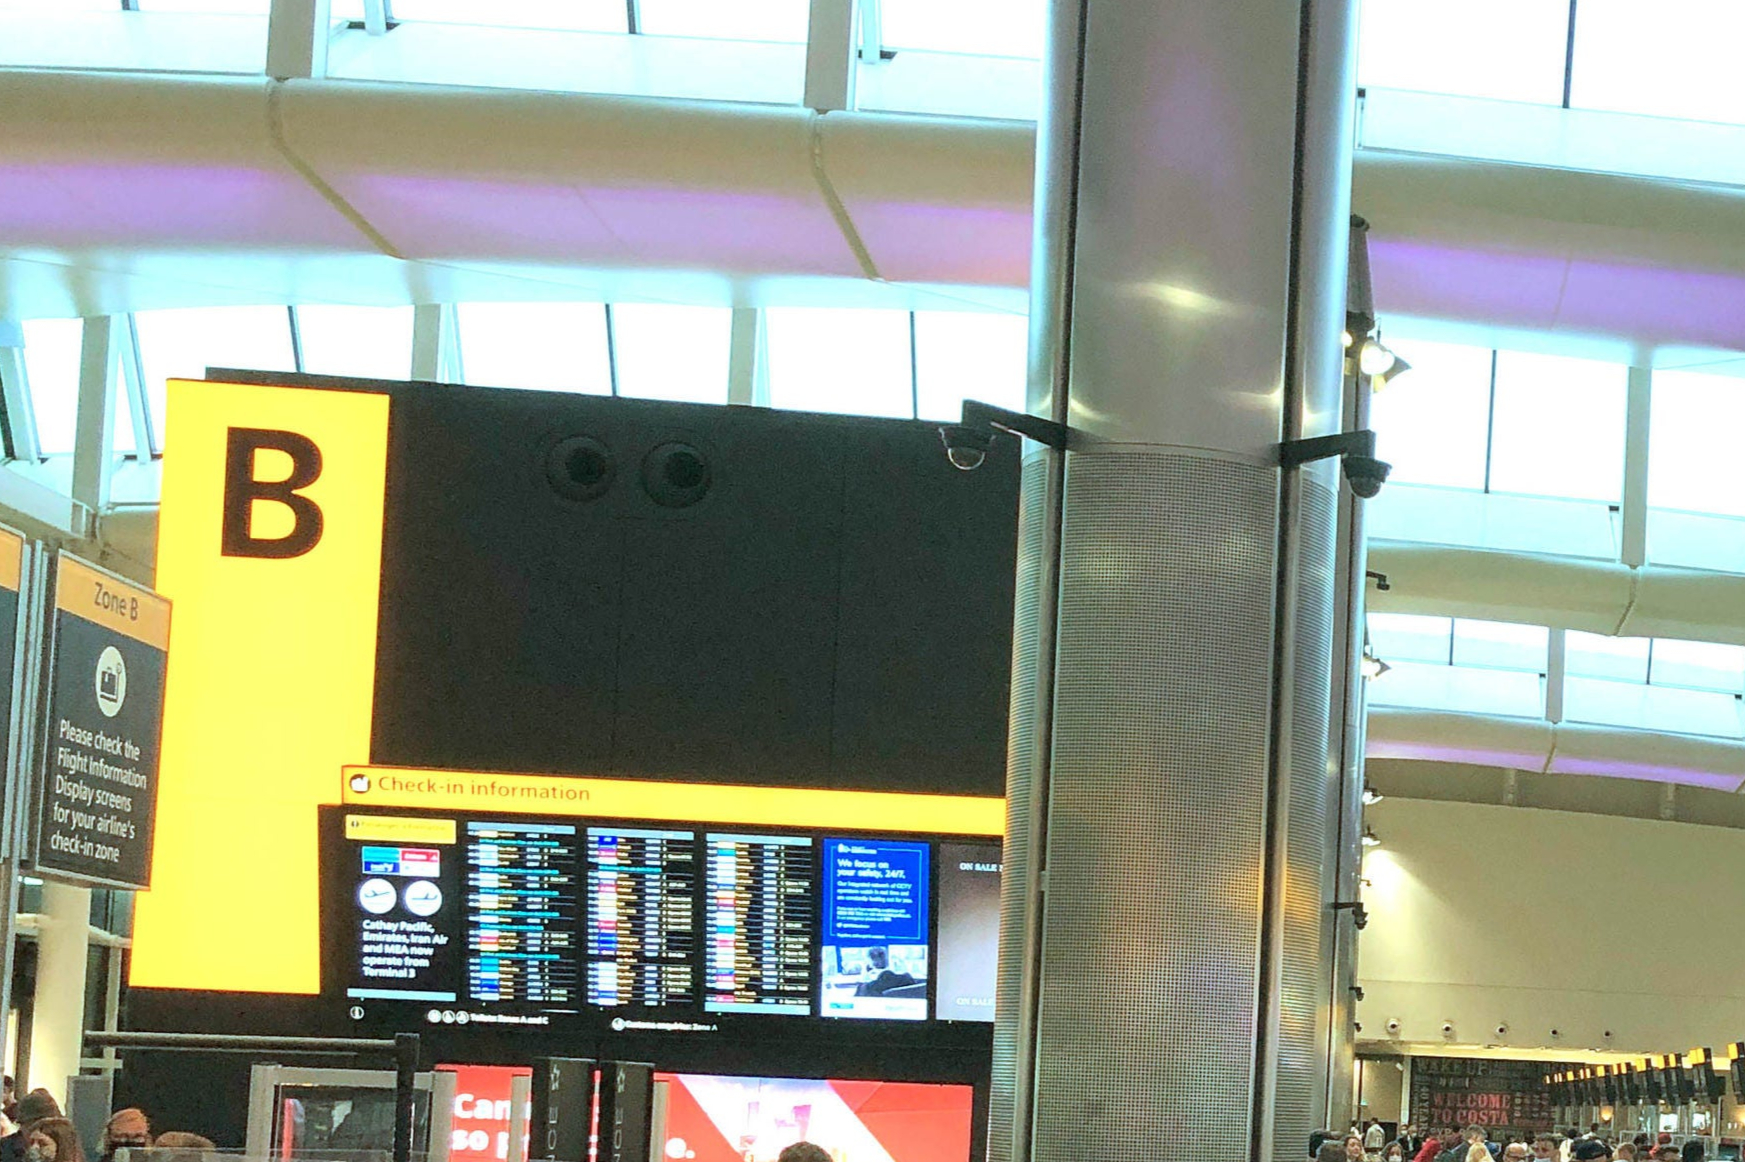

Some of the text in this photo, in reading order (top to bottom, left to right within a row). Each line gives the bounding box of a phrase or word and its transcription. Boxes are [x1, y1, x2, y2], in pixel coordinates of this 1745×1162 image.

[220, 426, 324, 560] B
[94, 582, 139, 621] Zone B
[60, 718, 140, 761] Please check the
[57, 746, 147, 790] Flight Information
[55, 774, 132, 812] Display screens
[378, 776, 590, 801] Check-in information
[53, 801, 135, 839] for your airline's
[51, 831, 120, 863] check-in zone
[837, 859, 853, 867] We
[854, 859, 876, 868] focus
[959, 862, 974, 871] ON
[837, 869, 856, 877] your
[362, 920, 435, 933] Cathay Pacific,
[362, 931, 449, 945] Emirates, Iran Air
[362, 943, 434, 956] and MEA now
[362, 956, 430, 967] operate from
[362, 966, 417, 979] Terminal 3
[1432, 1092, 1511, 1109] WELCOME
[1431, 1108, 1452, 1123] TO
[1456, 1109, 1510, 1126] COSTA
